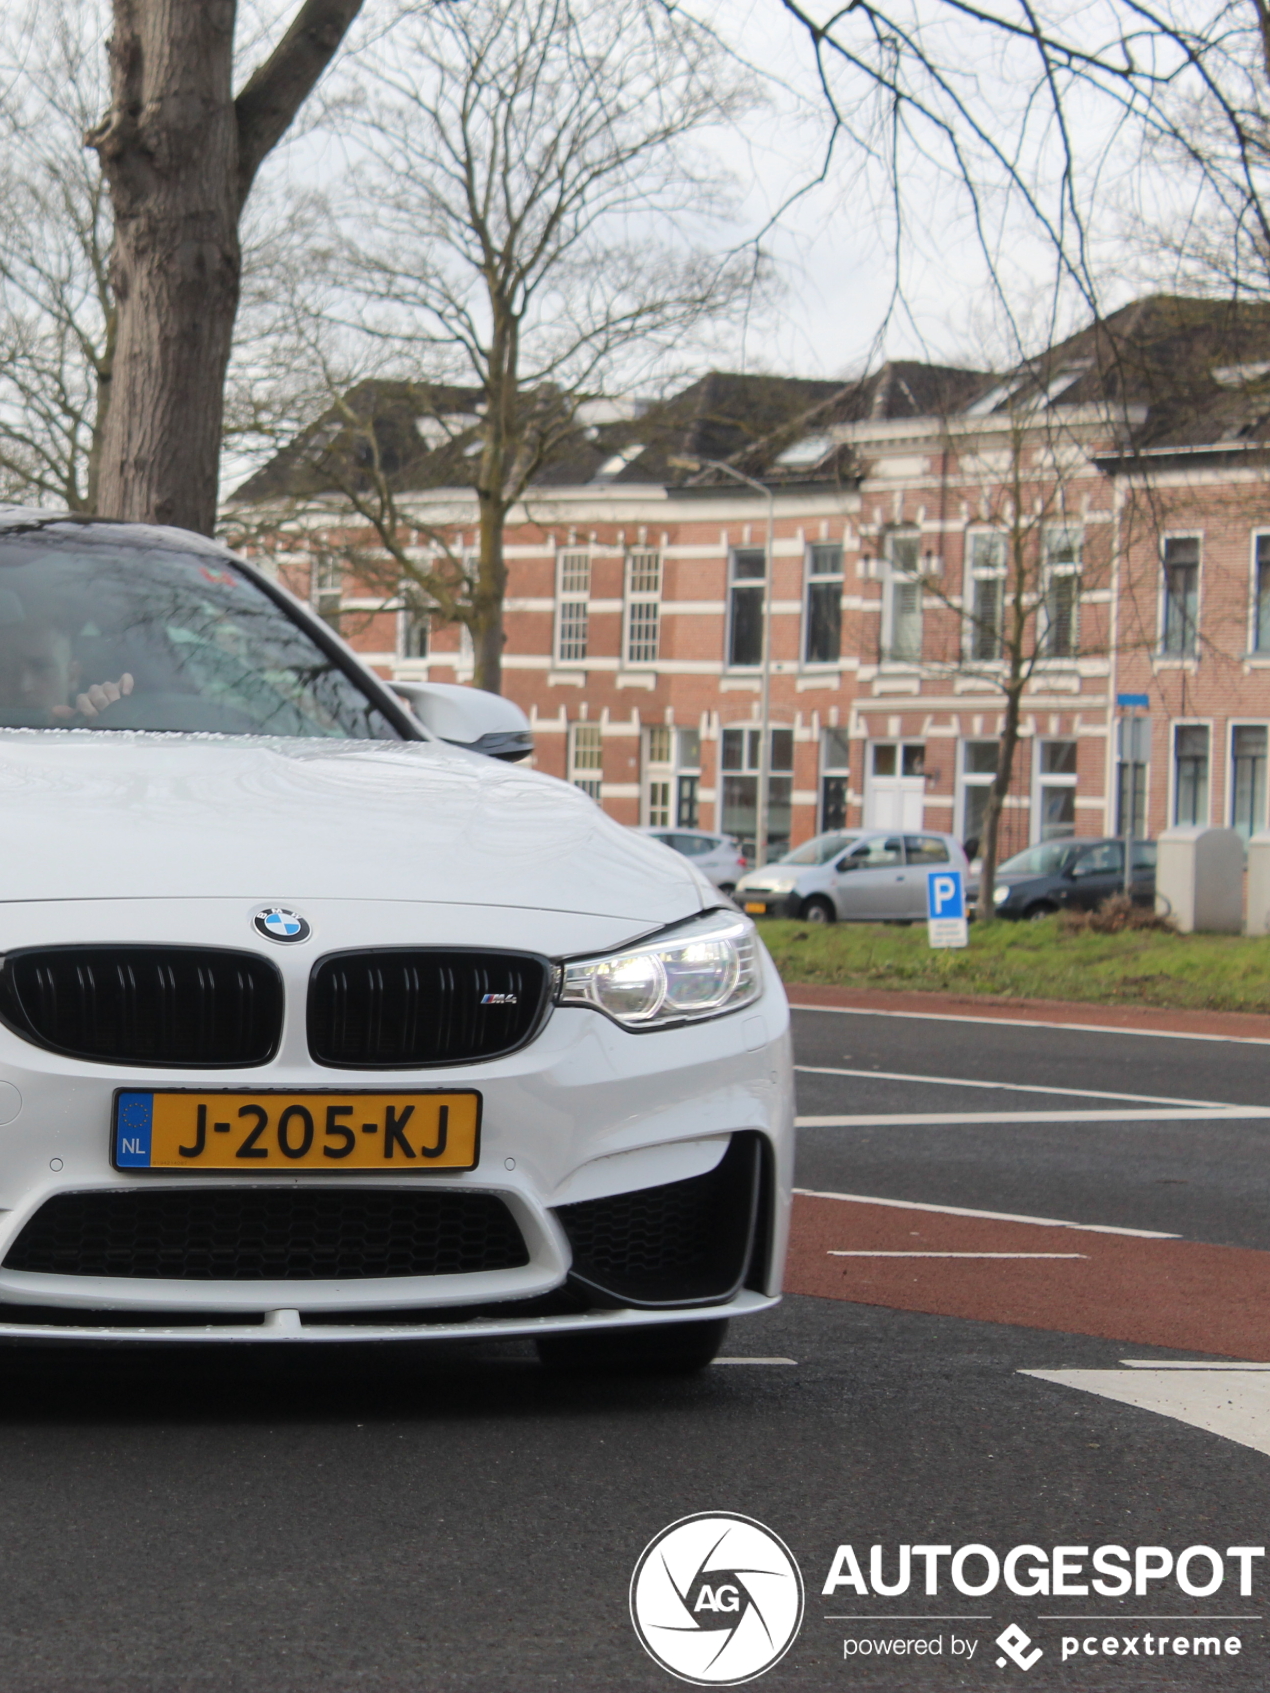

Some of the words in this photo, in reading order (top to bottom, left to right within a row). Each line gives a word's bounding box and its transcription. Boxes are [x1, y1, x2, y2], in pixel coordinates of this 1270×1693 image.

[934, 877, 955, 914] P
[486, 993, 517, 1004] M4
[179, 1104, 449, 1159] J-205-KJ
[122, 1138, 146, 1154] NL
